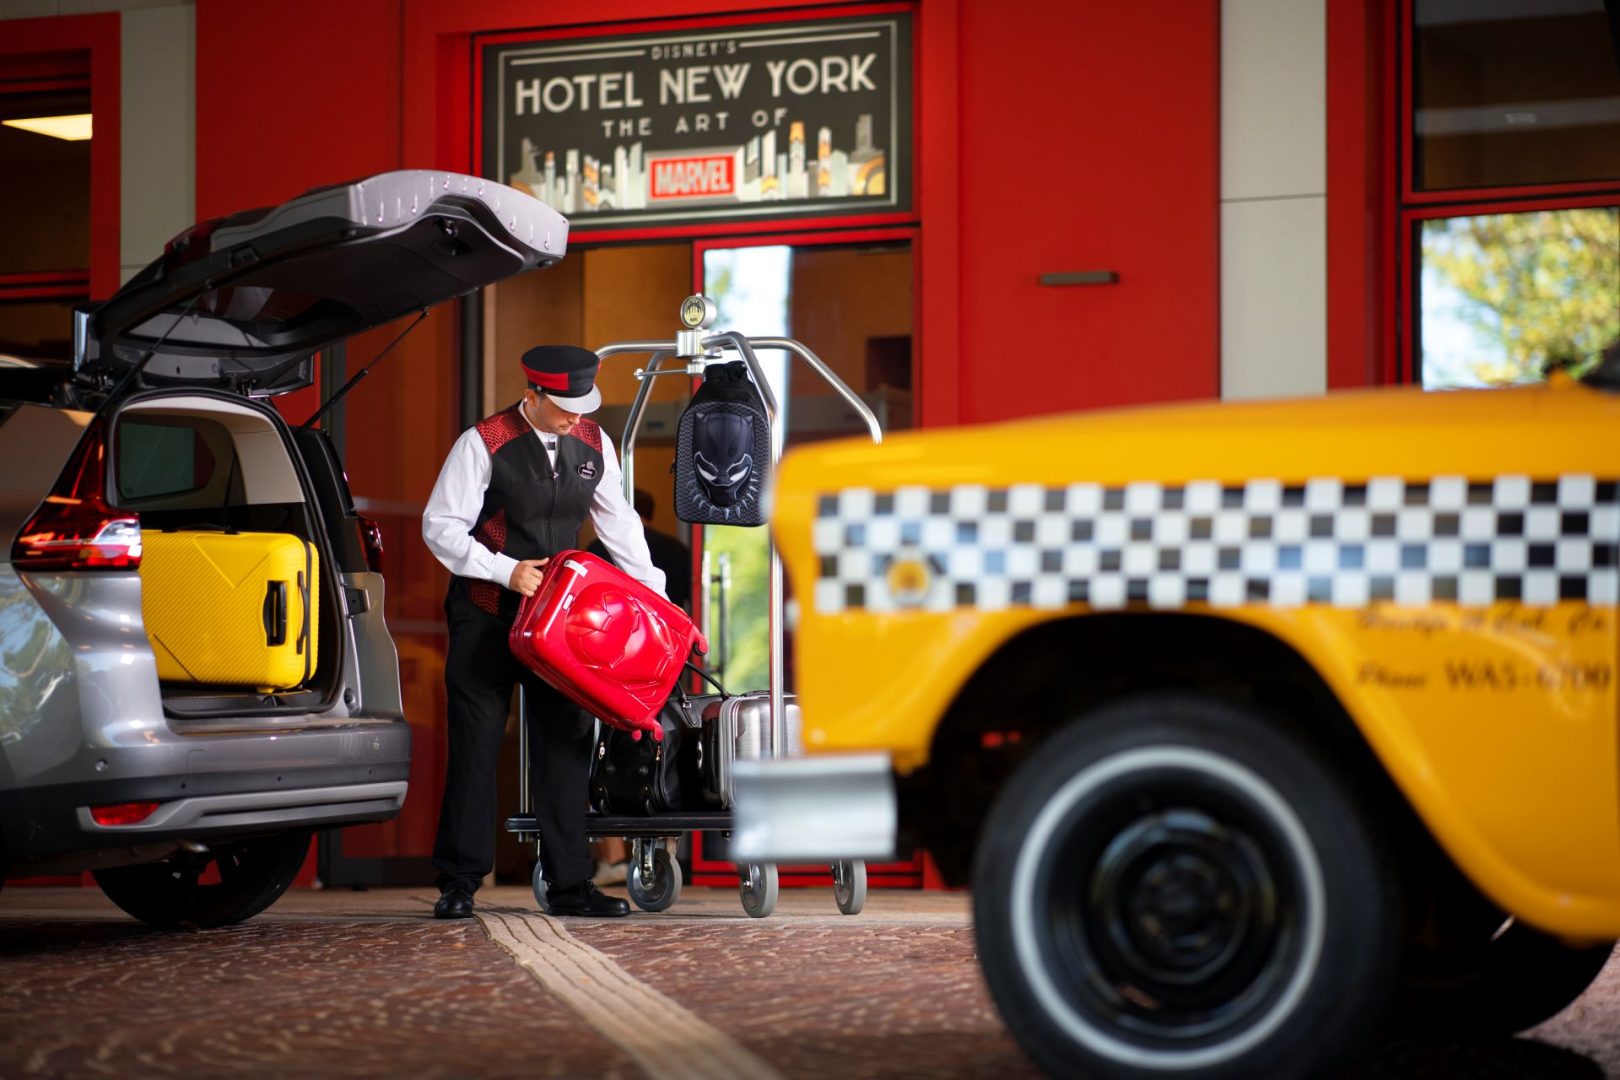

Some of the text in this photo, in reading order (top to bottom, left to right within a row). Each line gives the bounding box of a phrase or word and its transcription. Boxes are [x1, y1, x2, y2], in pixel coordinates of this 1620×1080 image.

[651, 40, 737, 60] DISNEY'S
[515, 53, 877, 116] HOTEL NEW YORK
[602, 107, 788, 138] THE ART OF
[655, 159, 731, 195] MARVEL
